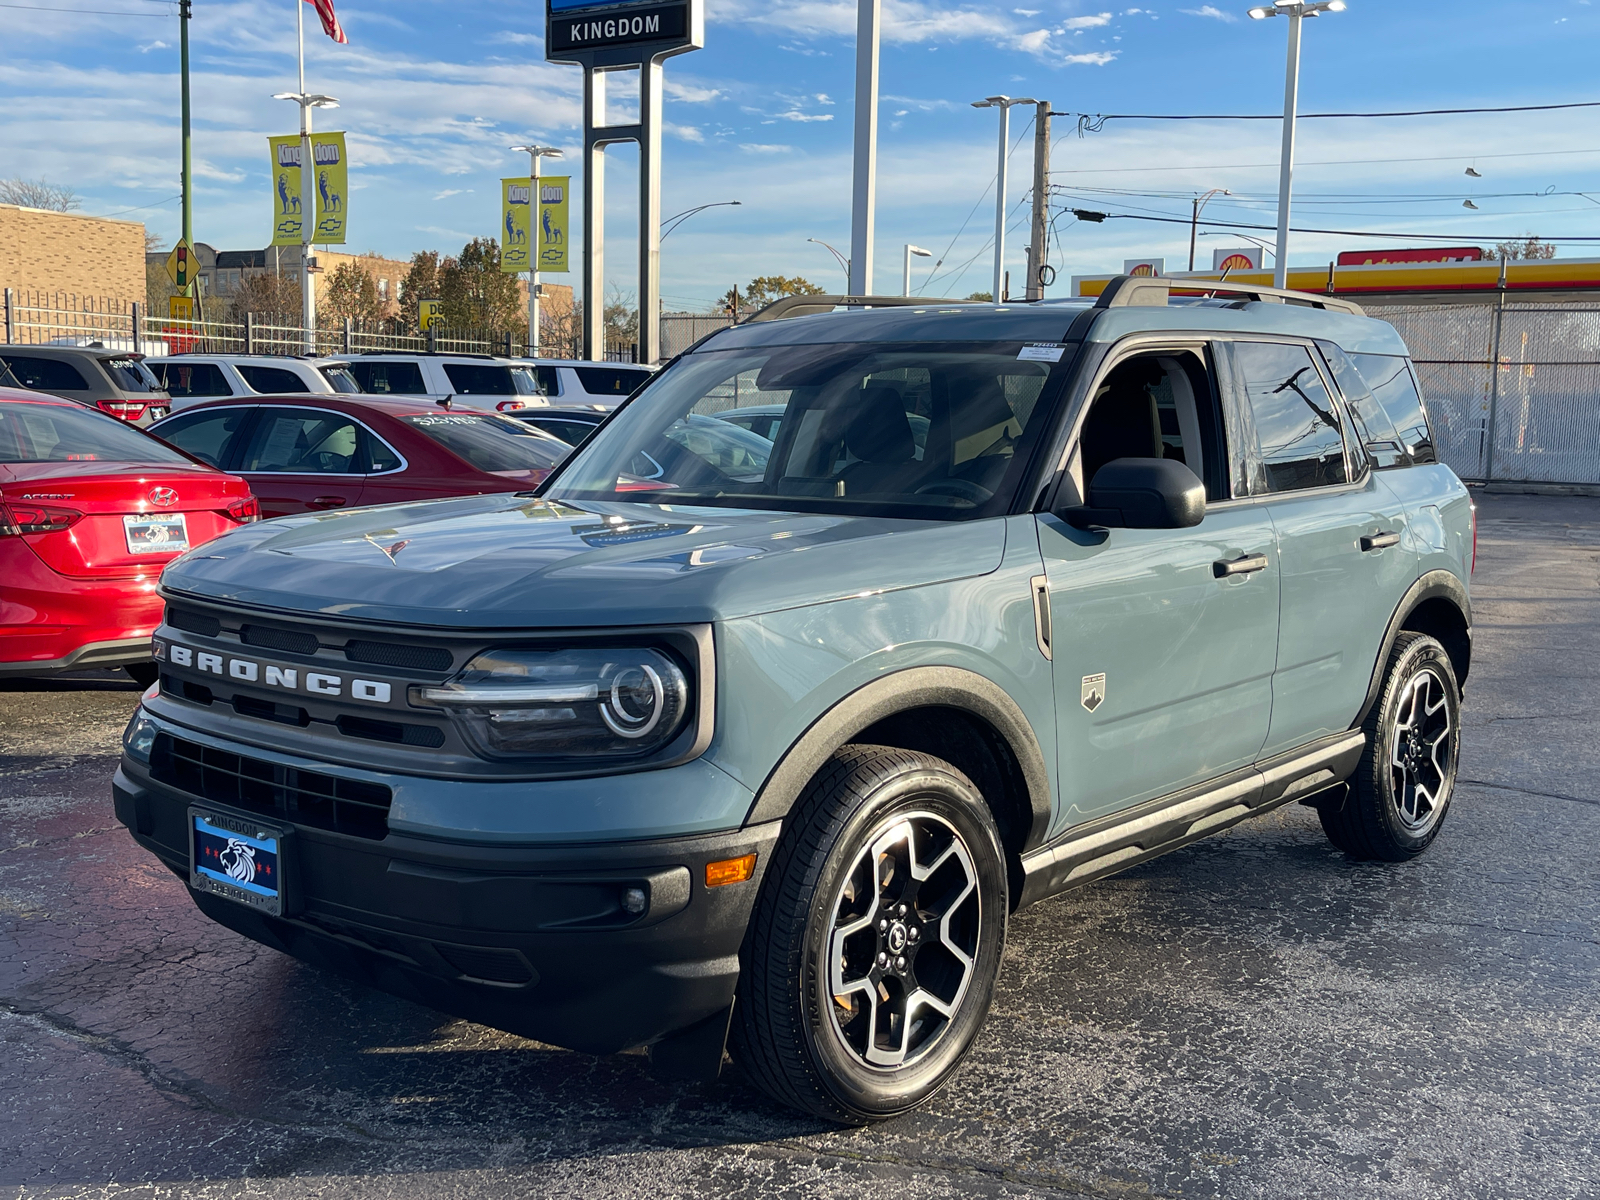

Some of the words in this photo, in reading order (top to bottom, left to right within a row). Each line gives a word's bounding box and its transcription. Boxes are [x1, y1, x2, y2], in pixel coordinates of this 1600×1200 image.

[571, 14, 660, 42] KINGDOM
[277, 143, 302, 166] King
[314, 142, 339, 164] dom
[508, 184, 530, 204] King
[541, 184, 563, 203] dom
[429, 304, 445, 315] DO
[170, 644, 392, 703] BRONCO
[210, 814, 258, 837] KINGDOM
[211, 883, 260, 905] CHEVROLET
